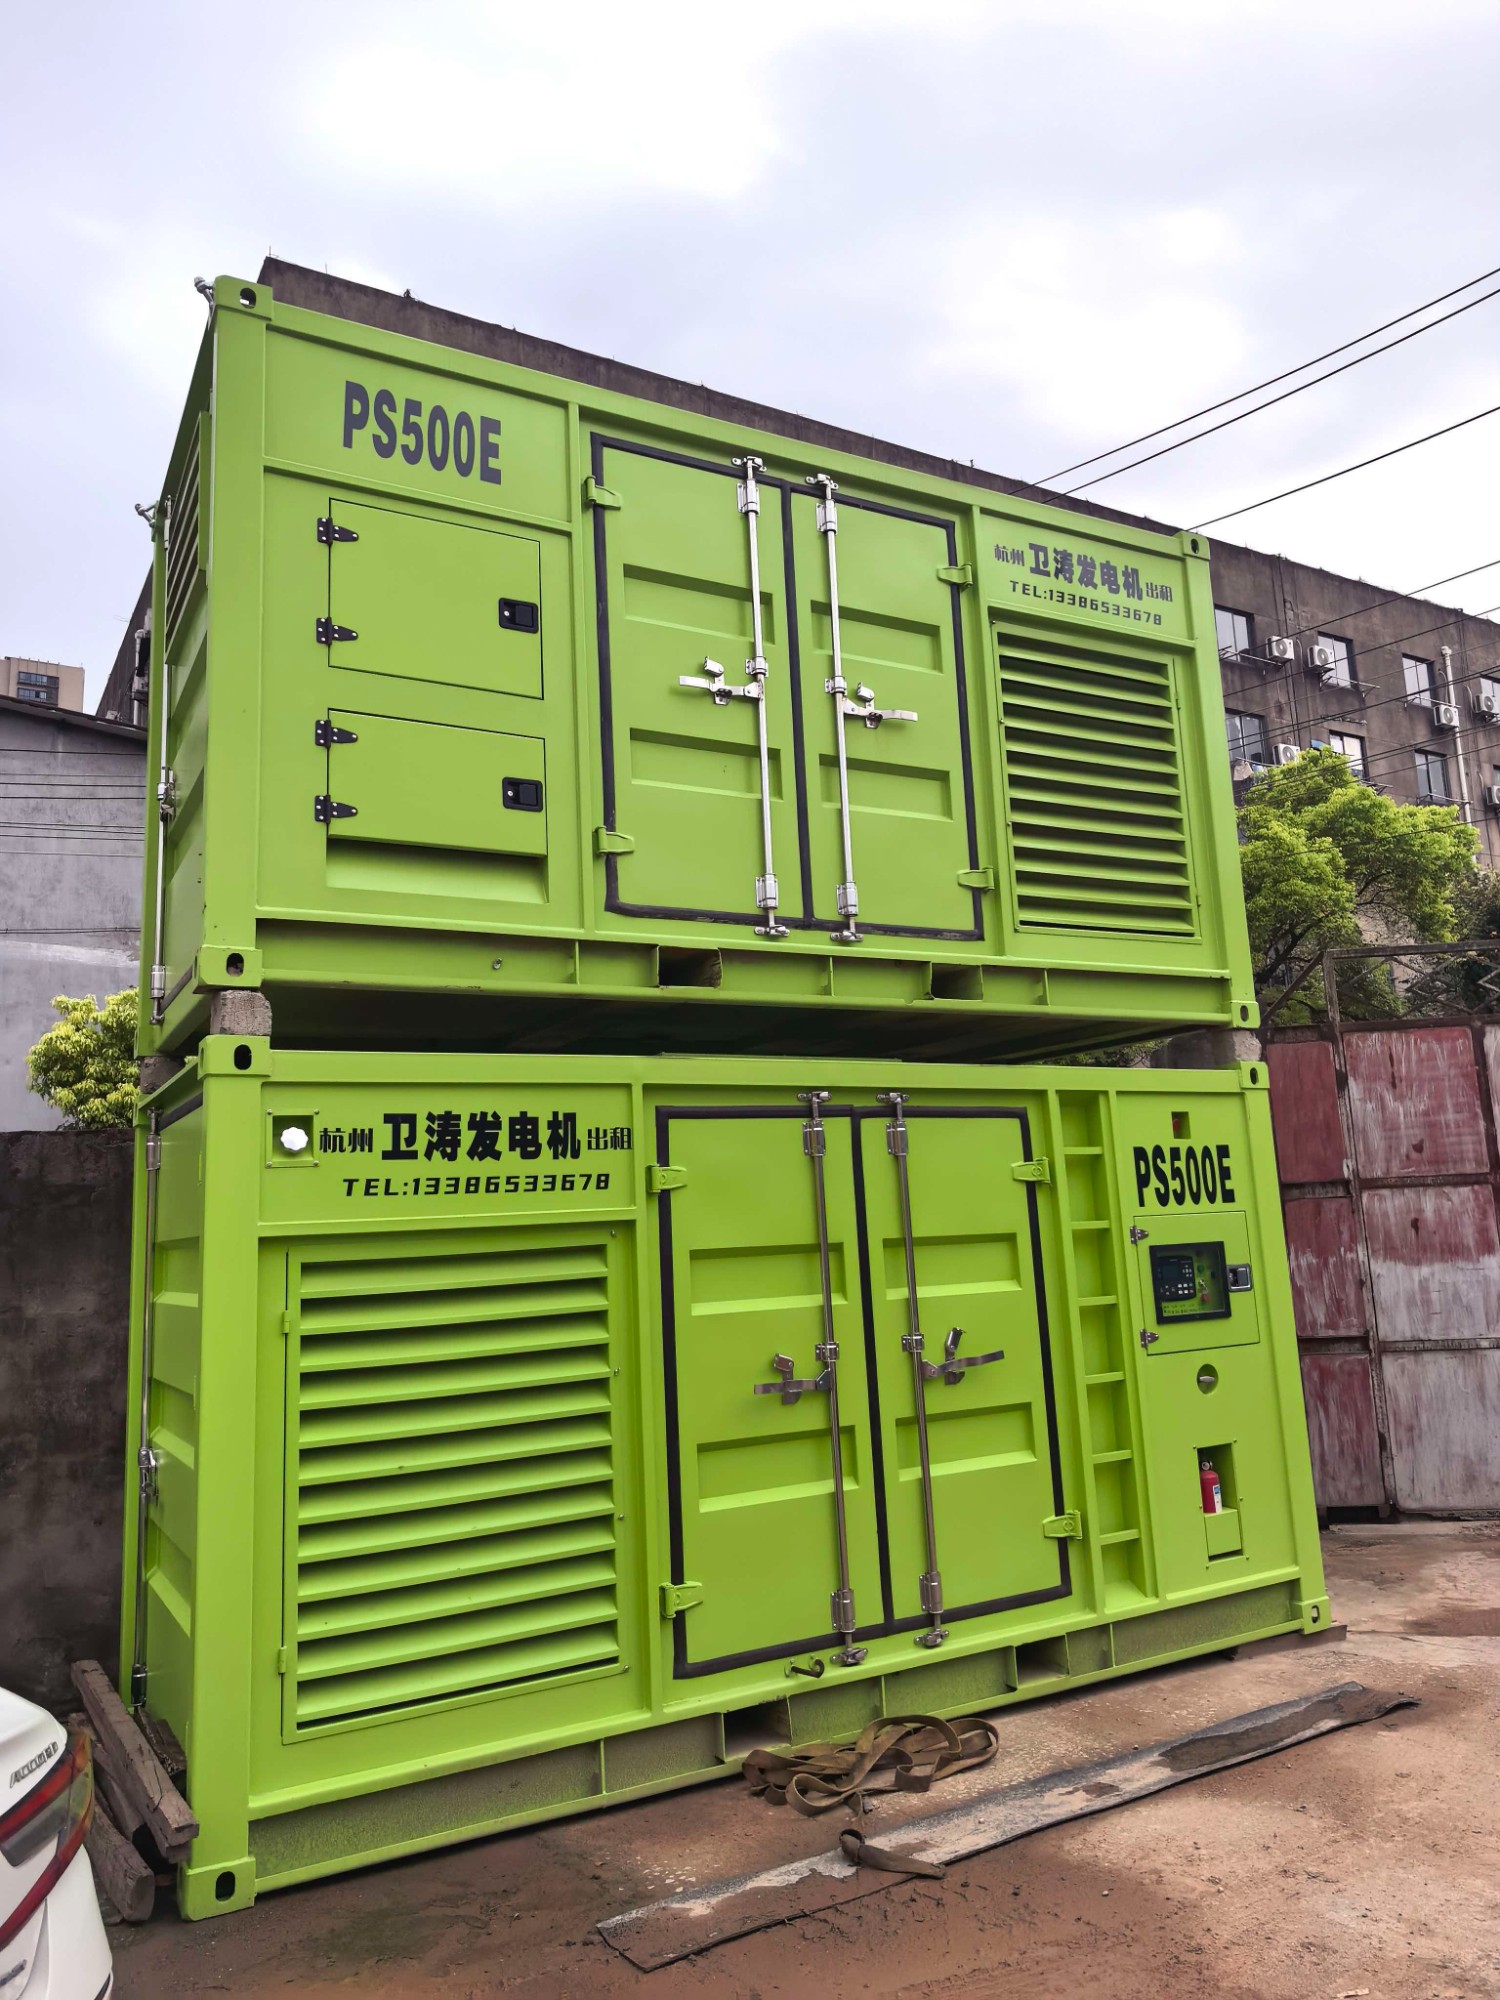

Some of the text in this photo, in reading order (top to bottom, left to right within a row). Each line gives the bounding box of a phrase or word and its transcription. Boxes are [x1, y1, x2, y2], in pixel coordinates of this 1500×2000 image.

[343, 380, 501, 485] PS500E
[1010, 580, 1162, 625] TEL:13386533678
[343, 1173, 610, 1197] TEL:13386533678
[1133, 1144, 1236, 1207] PS500E
